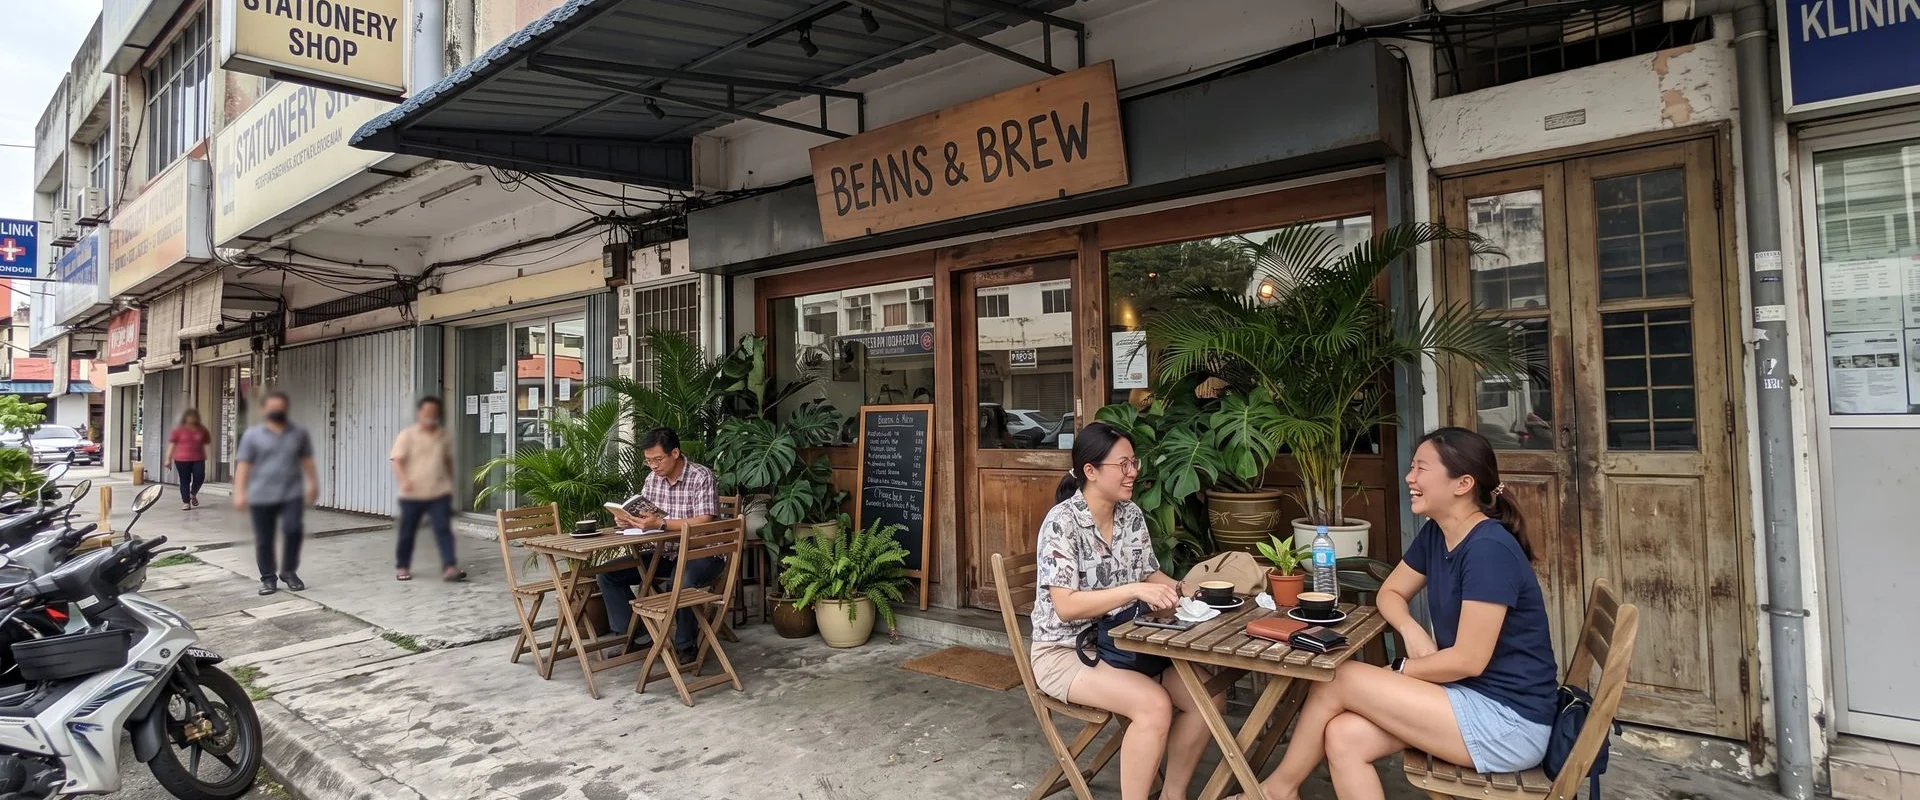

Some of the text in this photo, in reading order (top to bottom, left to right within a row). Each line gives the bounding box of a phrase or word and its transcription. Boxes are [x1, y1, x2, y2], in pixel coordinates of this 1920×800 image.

[289, 28, 358, 65] SHOP
[235, 86, 318, 179] STATIONERY
[831, 102, 1089, 217] BEANS & BREW
